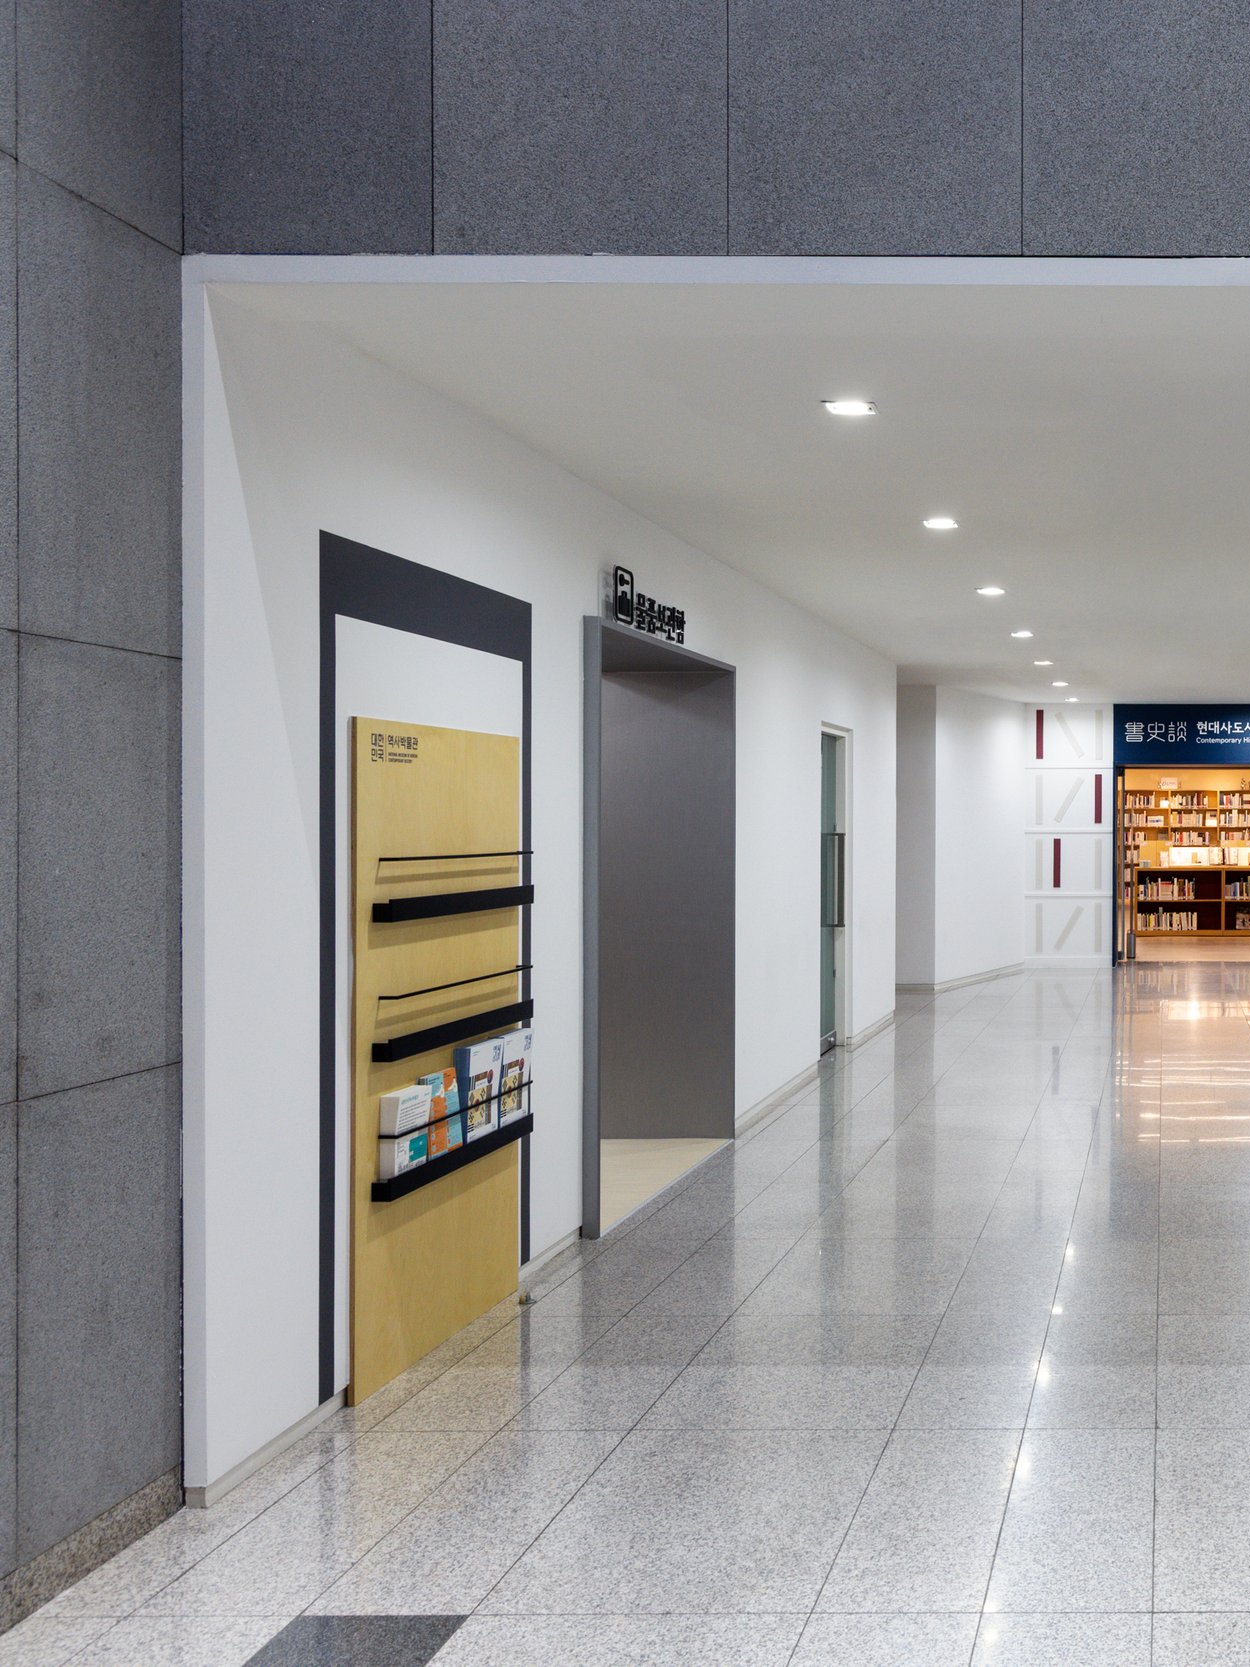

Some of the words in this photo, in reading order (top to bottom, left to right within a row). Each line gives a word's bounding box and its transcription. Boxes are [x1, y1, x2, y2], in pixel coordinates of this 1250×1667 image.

[635, 593, 686, 644] 물품보관함
[387, 734, 419, 750] 역사박물관
[1196, 737, 1242, 745] Contemporary
